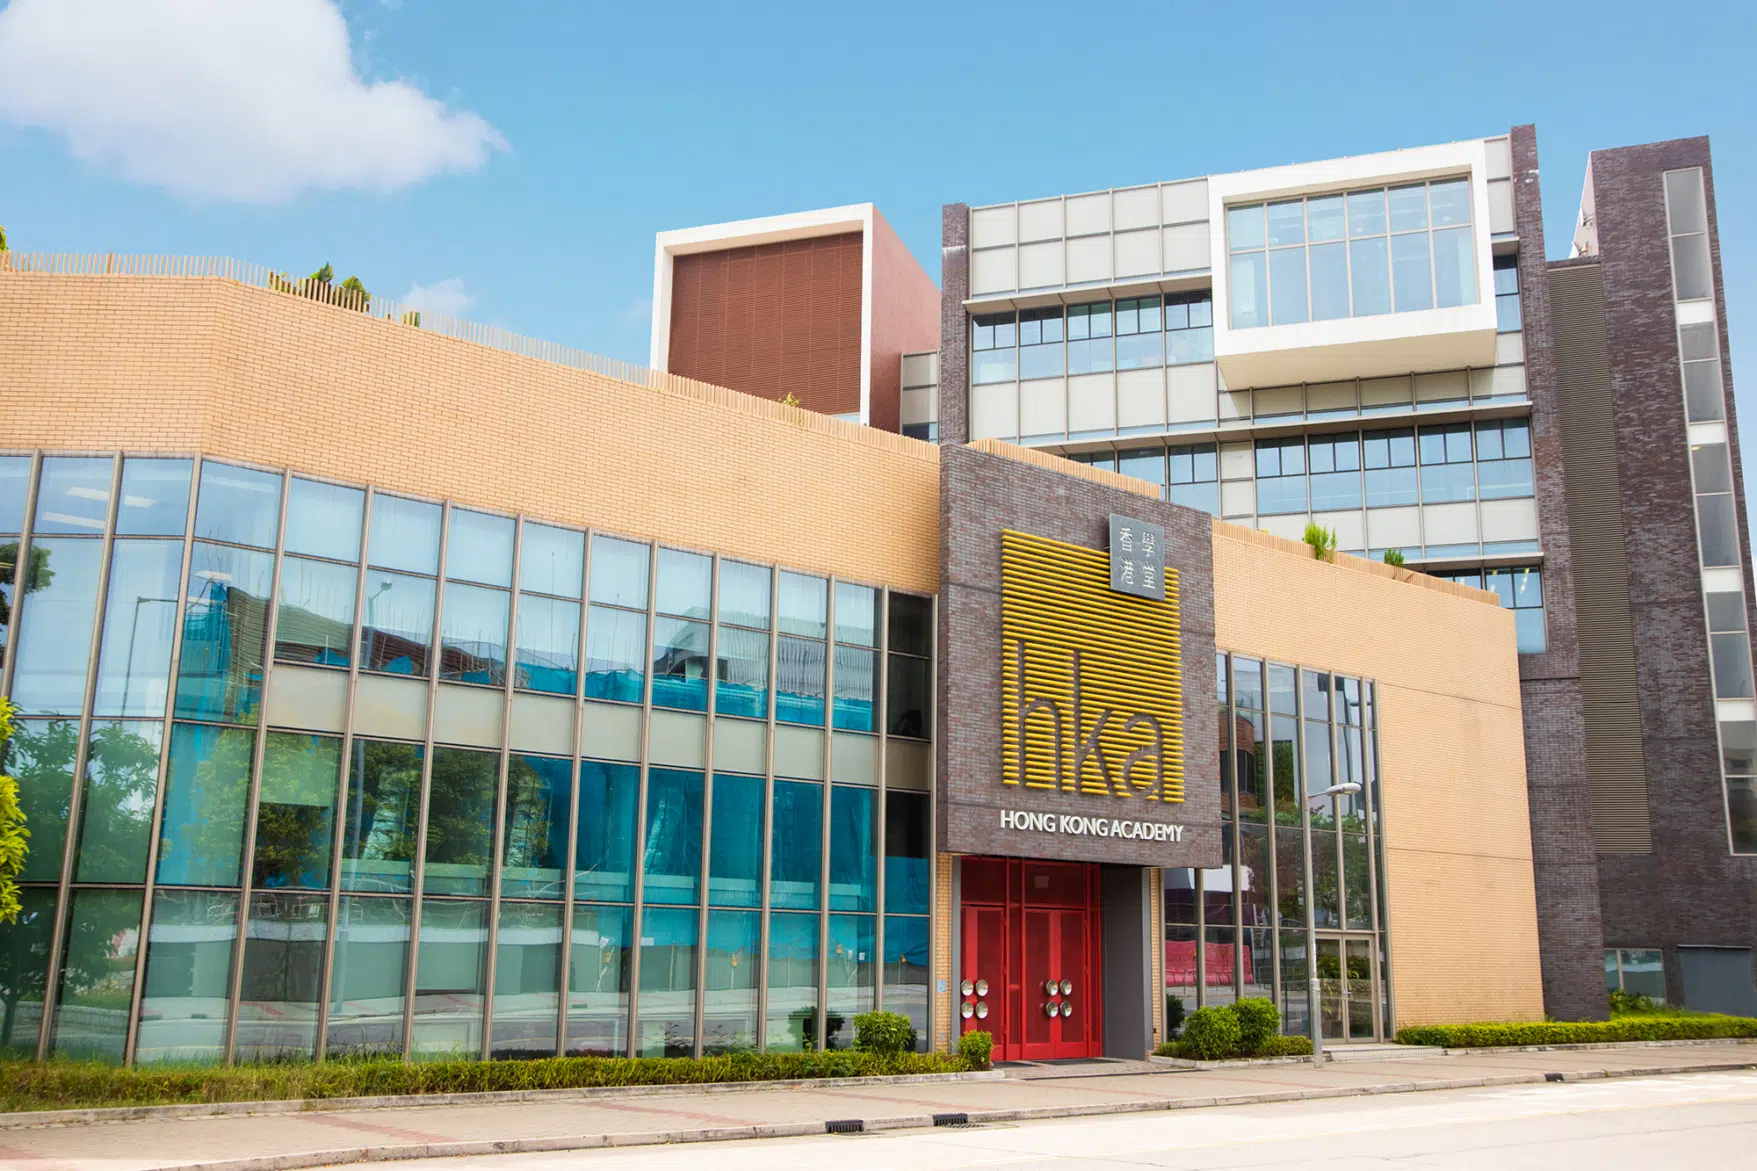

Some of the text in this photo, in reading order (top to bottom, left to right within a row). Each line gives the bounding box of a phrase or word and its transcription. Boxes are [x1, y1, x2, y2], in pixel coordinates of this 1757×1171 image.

[1018, 640, 1164, 799] hka
[1000, 809, 1184, 842] HONG KONG ACADEMY
